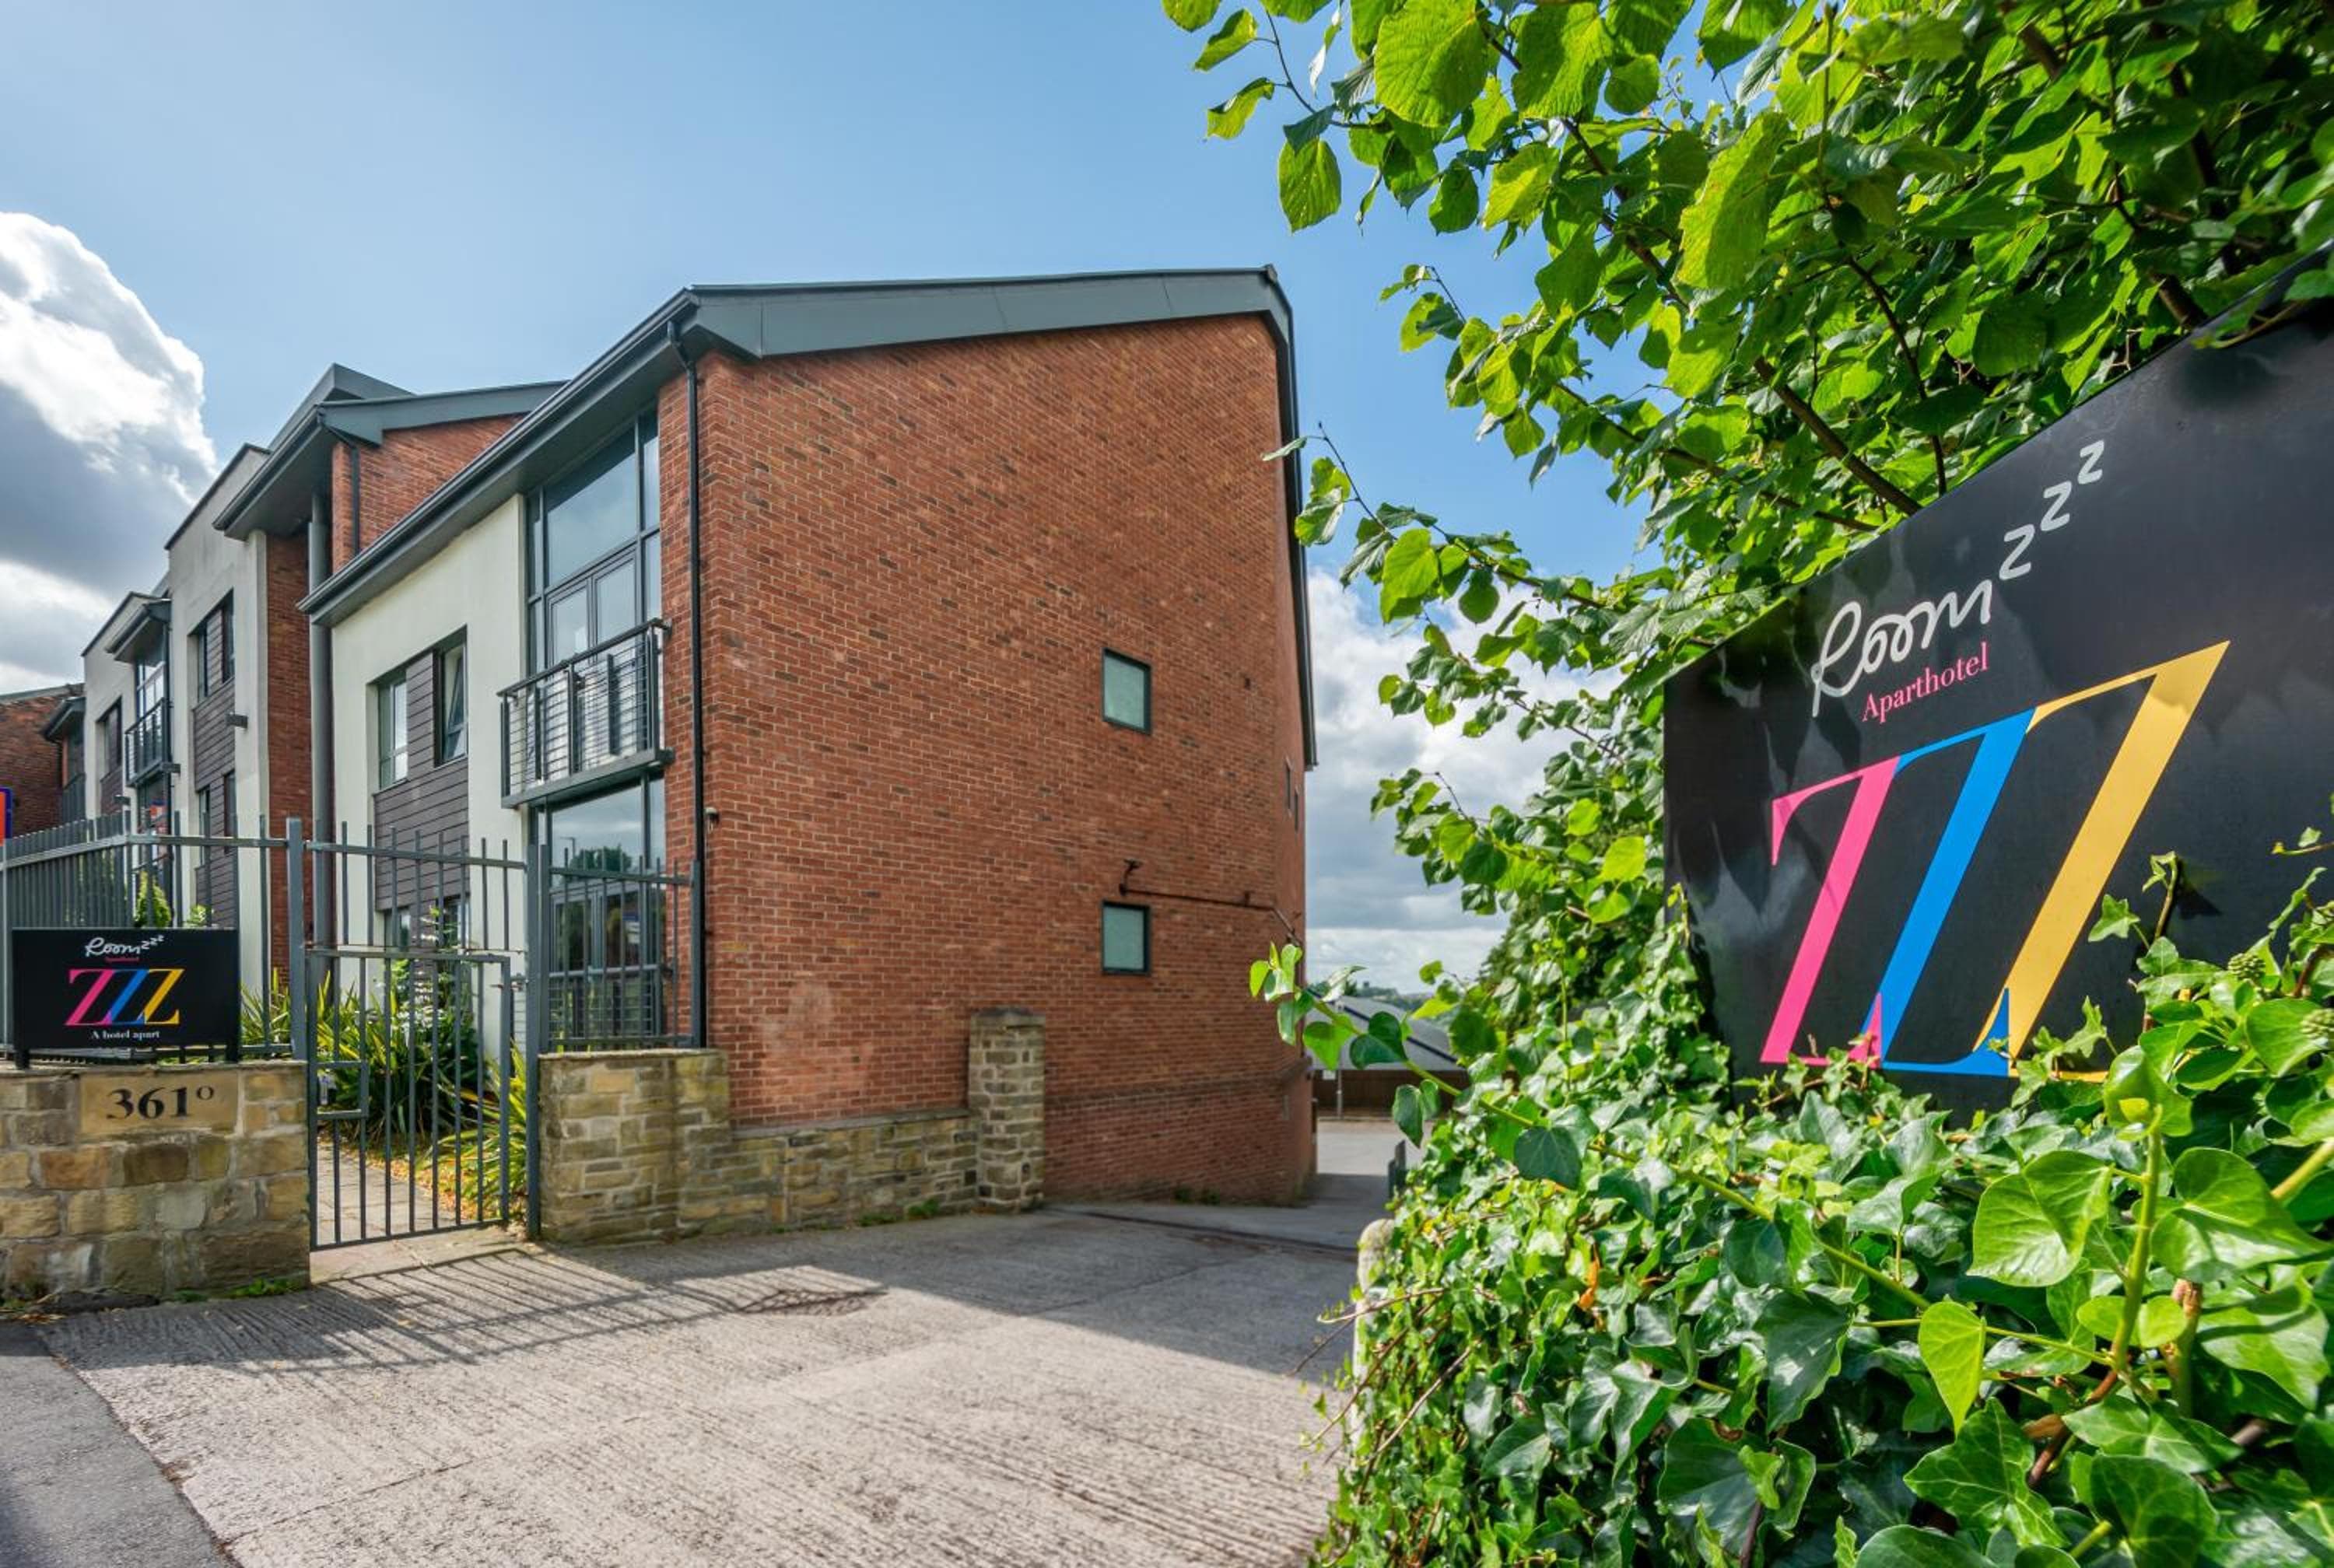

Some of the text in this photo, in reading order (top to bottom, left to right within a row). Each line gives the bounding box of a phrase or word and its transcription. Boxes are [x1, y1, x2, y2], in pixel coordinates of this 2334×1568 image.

[1862, 642, 1990, 724] Aparthotel
[91, 1028, 160, 1041] A hotel apart
